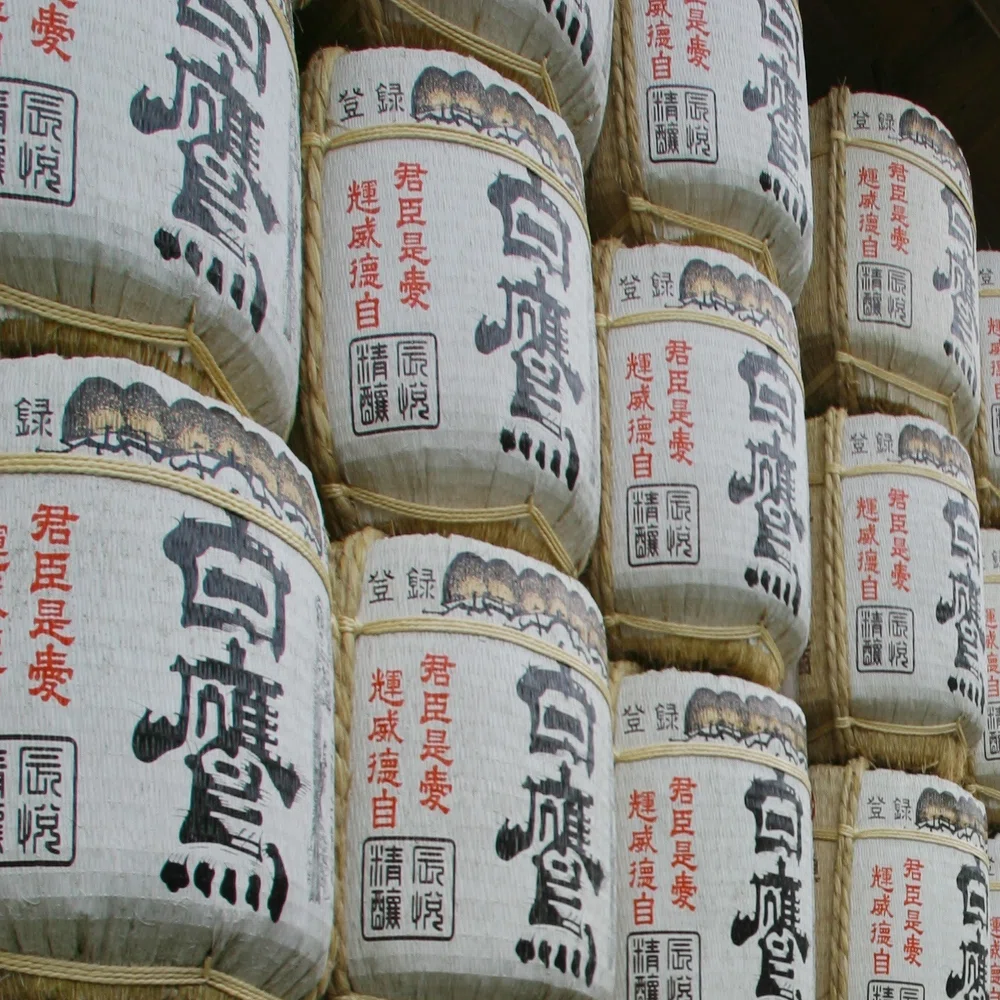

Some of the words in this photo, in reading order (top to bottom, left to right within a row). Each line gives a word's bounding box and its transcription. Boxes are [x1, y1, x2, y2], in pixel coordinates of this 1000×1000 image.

[474, 158, 585, 491] 白鷹
[728, 335, 806, 608] 白鷹
[132, 489, 310, 922] 白鷹
[495, 655, 606, 988] 白鷹
